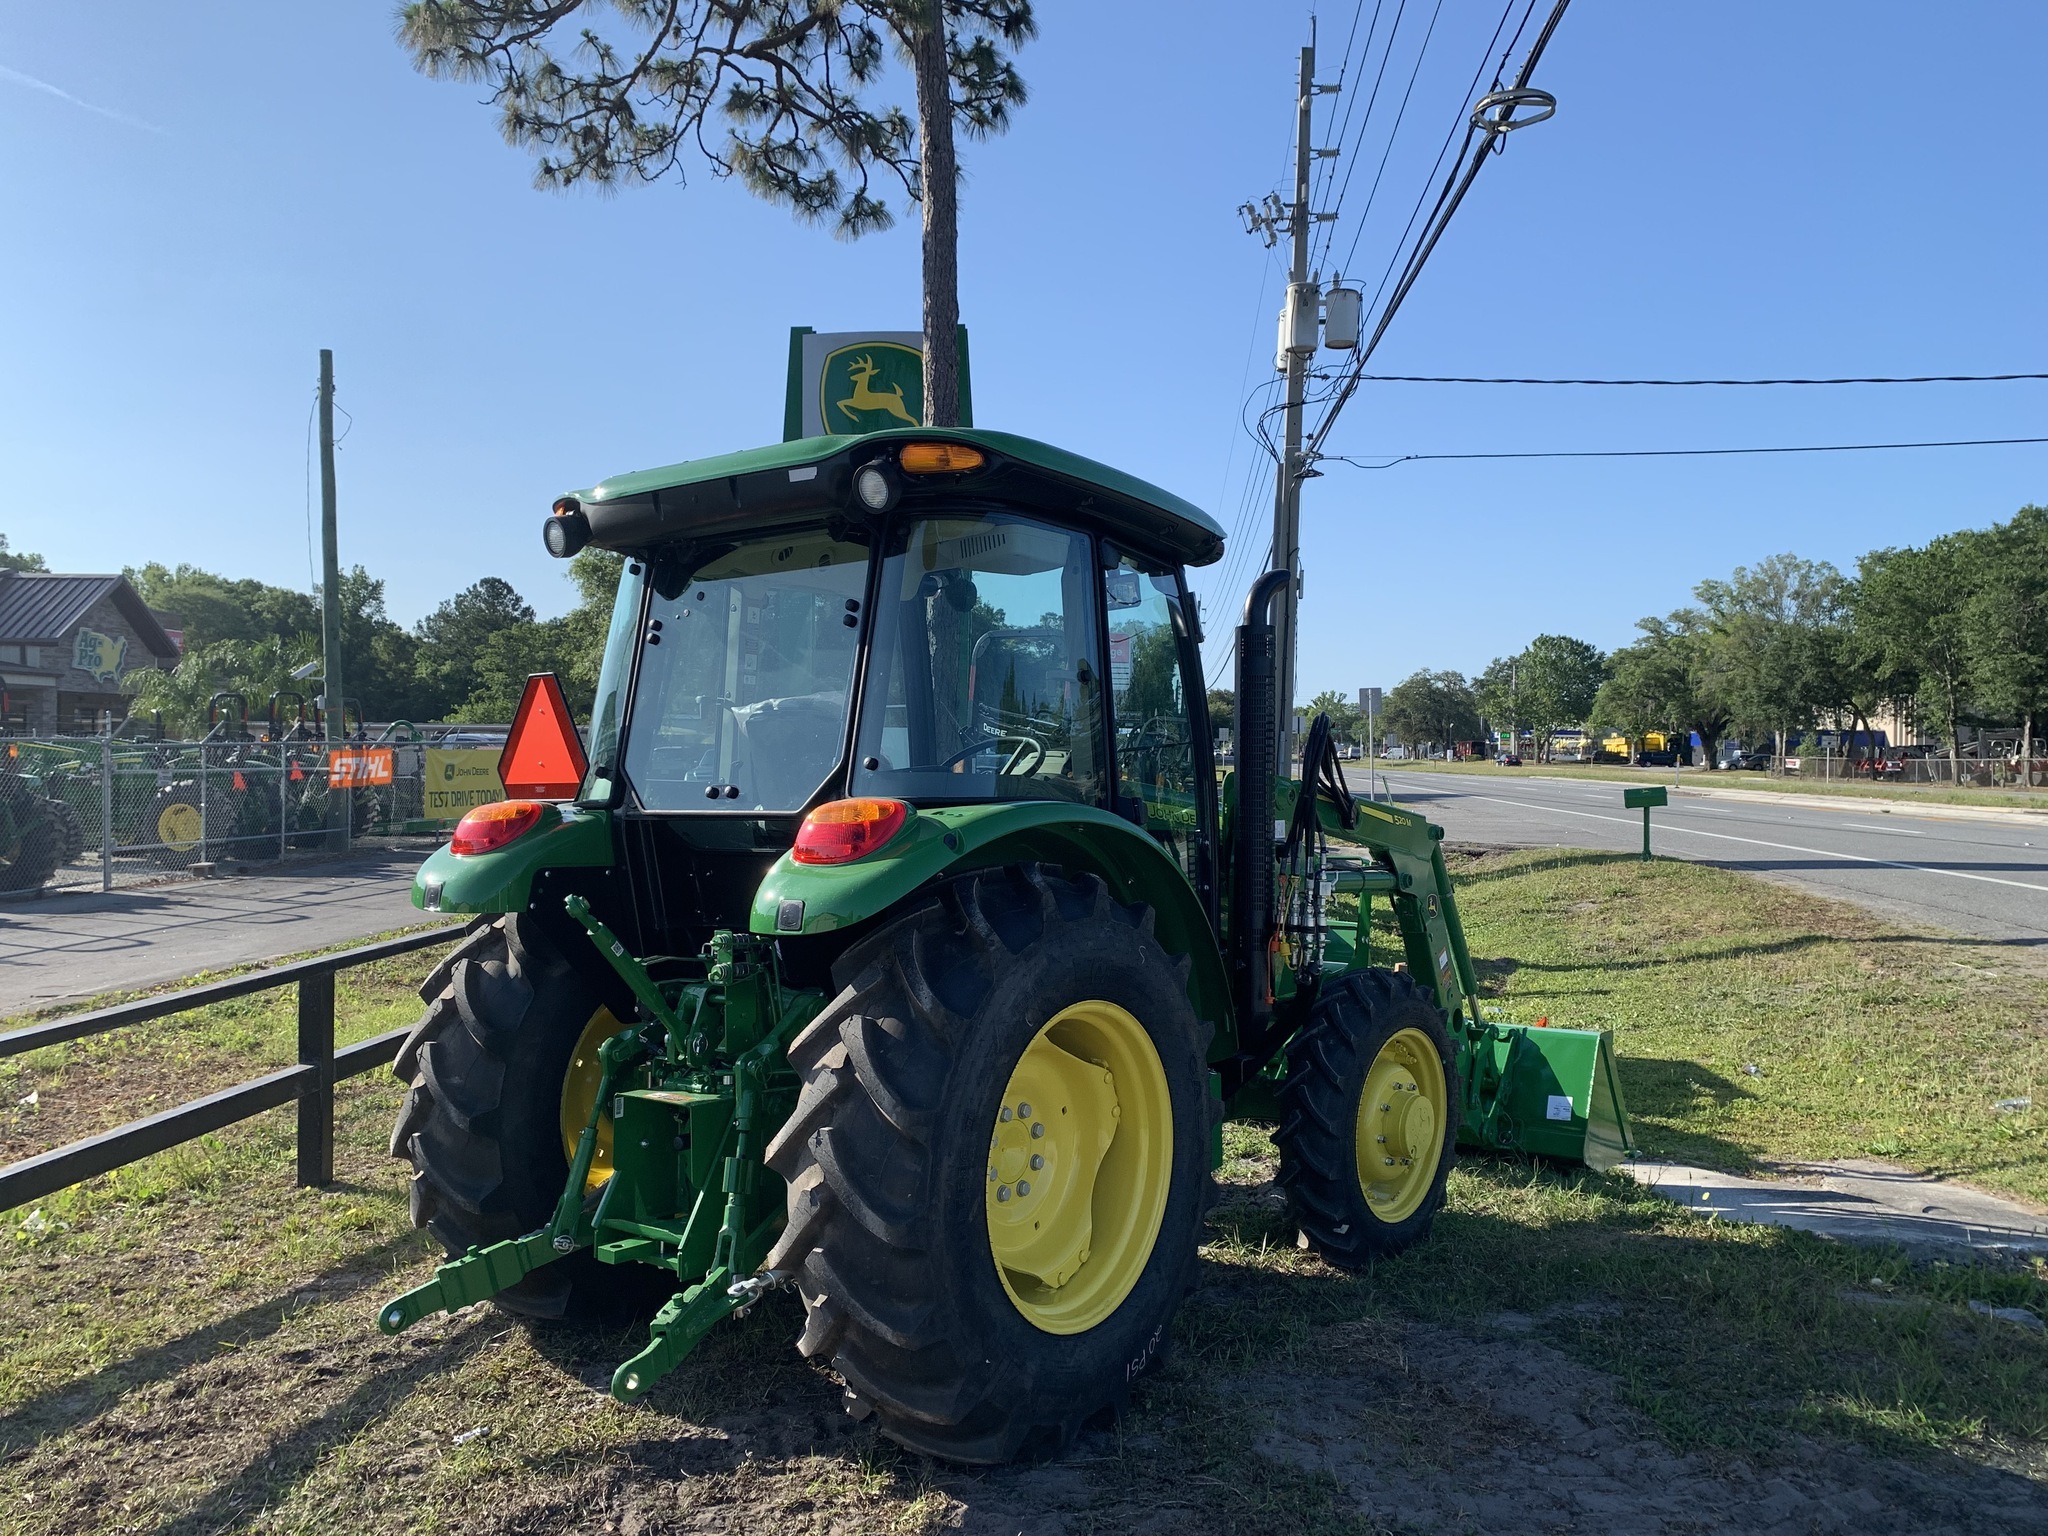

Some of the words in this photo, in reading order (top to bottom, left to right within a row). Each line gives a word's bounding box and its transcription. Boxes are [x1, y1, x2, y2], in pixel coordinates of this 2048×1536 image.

[79, 630, 103, 652] Ag-
[78, 648, 103, 667] Pro
[983, 722, 1008, 738] DEERE
[330, 755, 389, 781] STIHL
[456, 767, 471, 777] JOHN
[472, 766, 490, 776] DEERE
[429, 791, 449, 808] TEST
[451, 790, 475, 807] DRIVE
